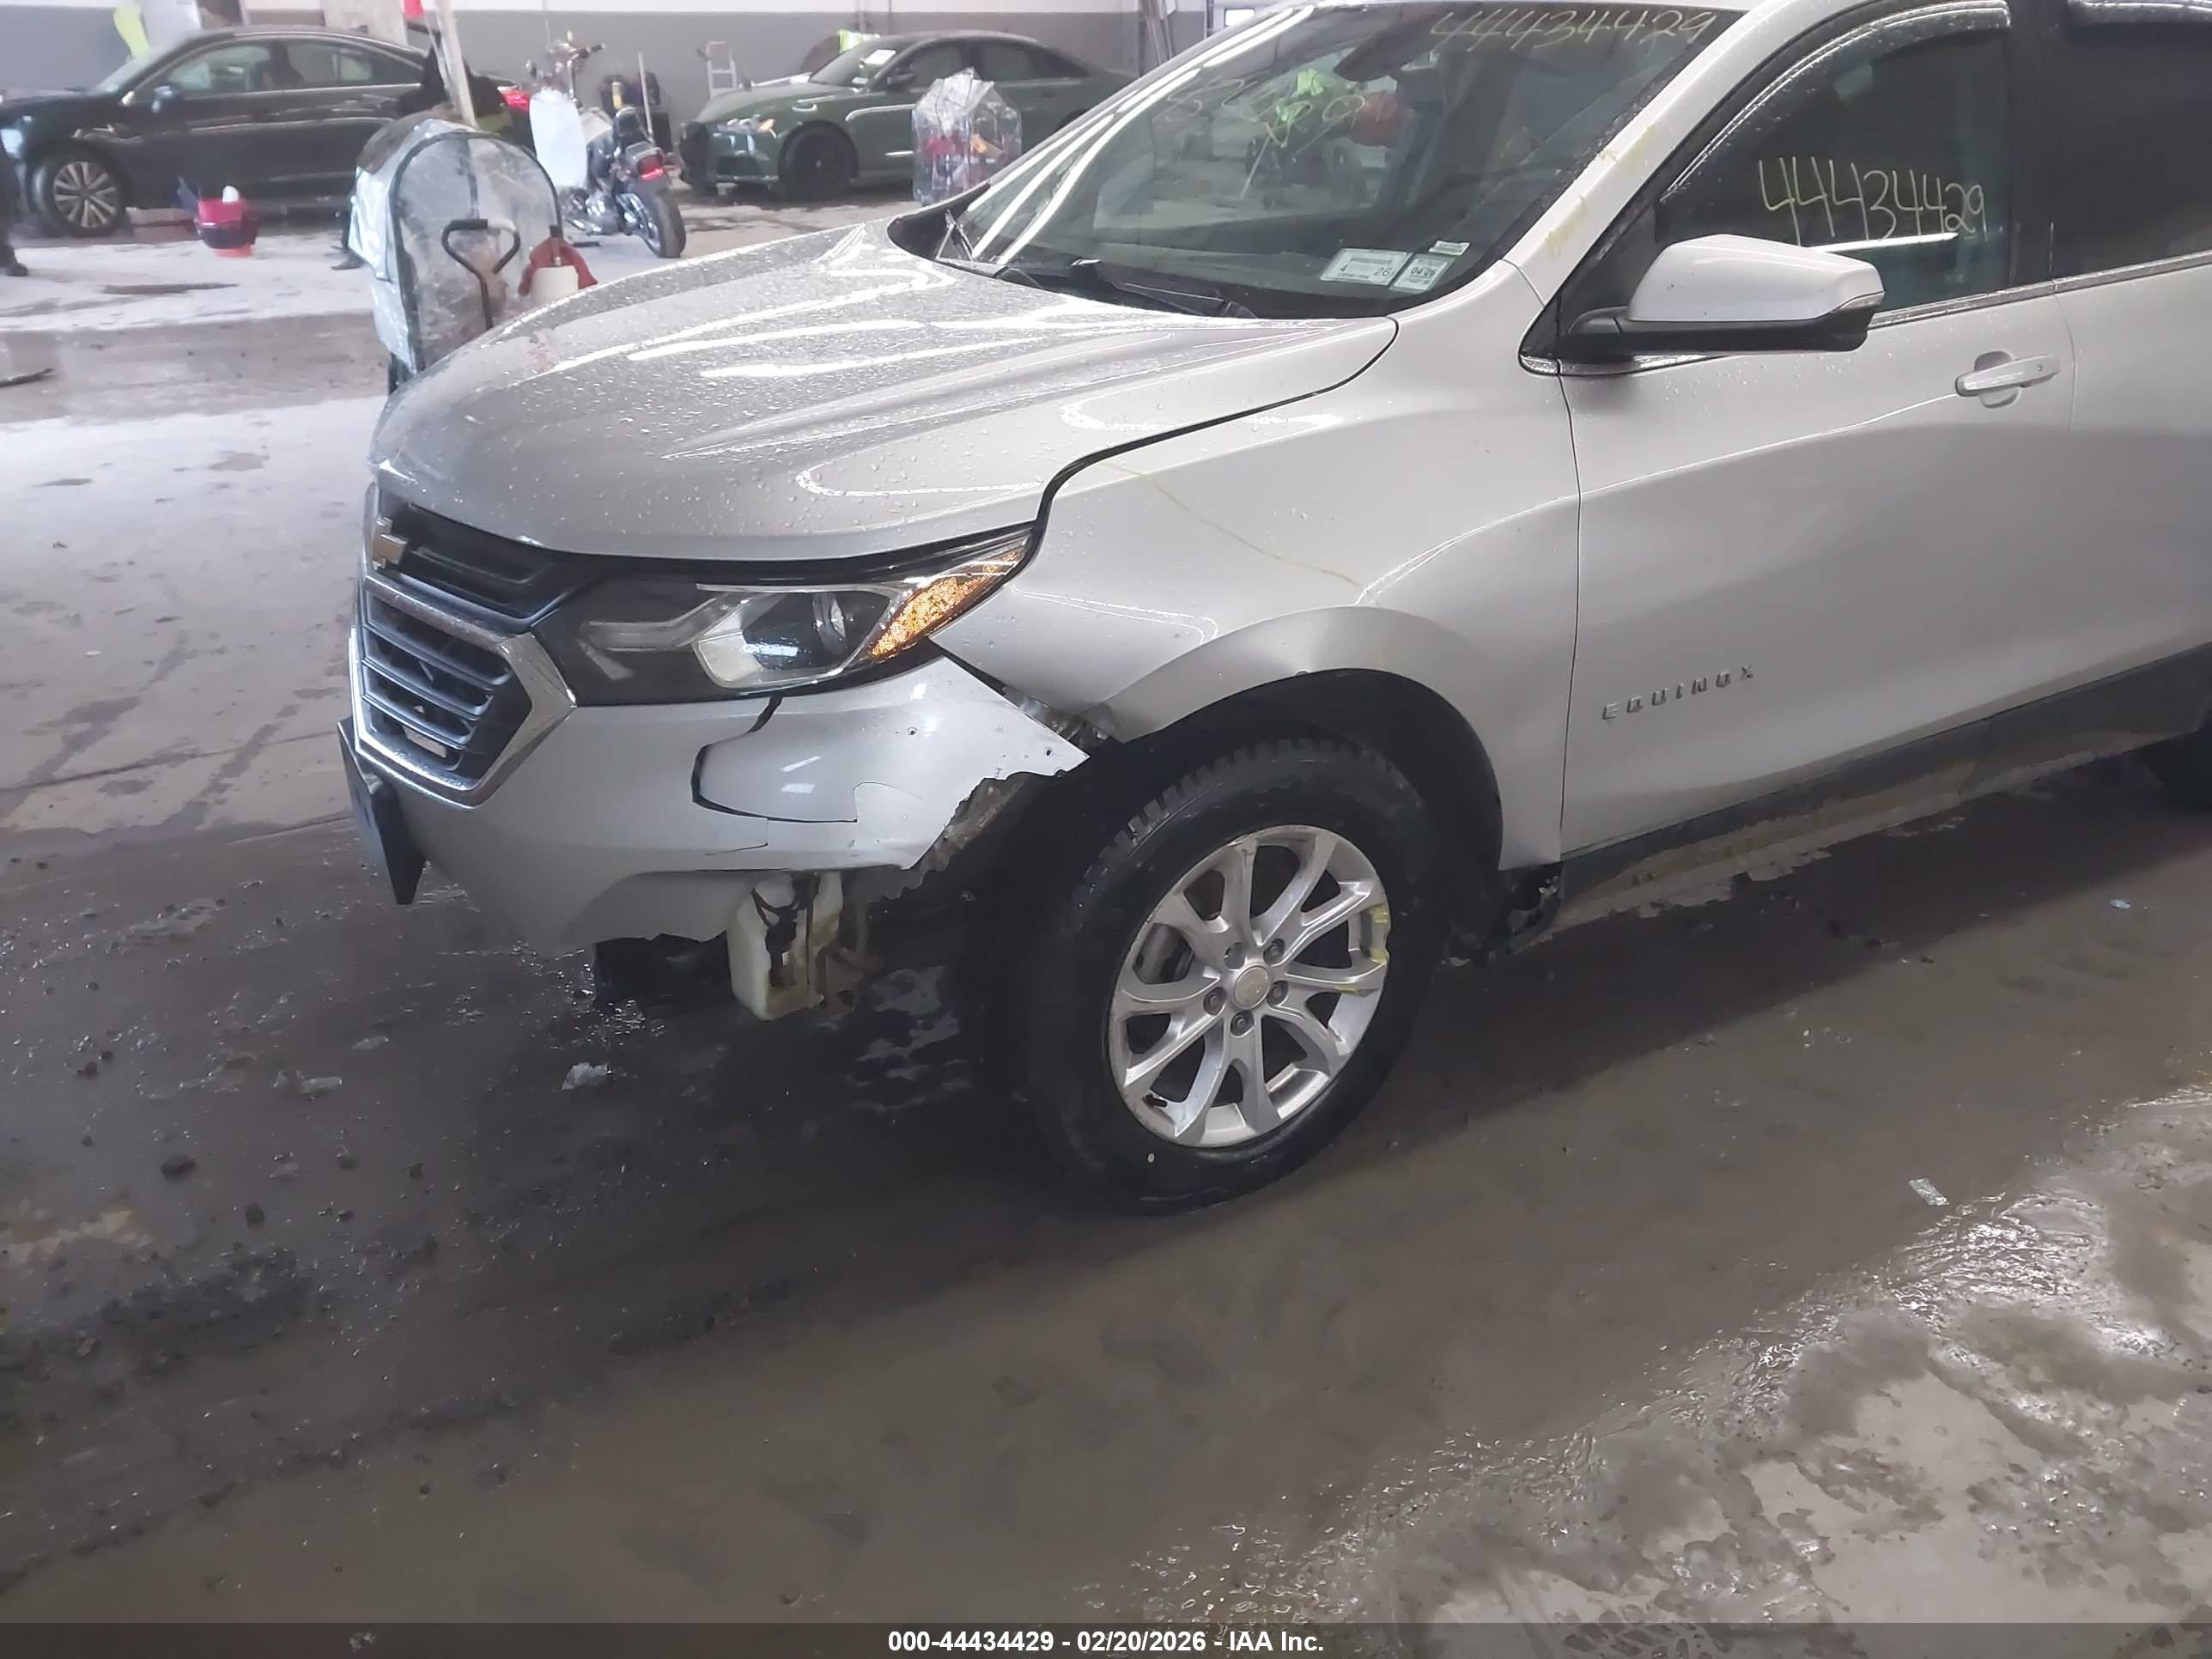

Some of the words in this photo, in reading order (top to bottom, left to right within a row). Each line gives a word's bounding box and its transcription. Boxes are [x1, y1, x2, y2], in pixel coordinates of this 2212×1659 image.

[1430, 9, 1717, 52] 44434429
[1759, 156, 1988, 246] 44434429
[1601, 665, 1754, 721] EQUINOX
